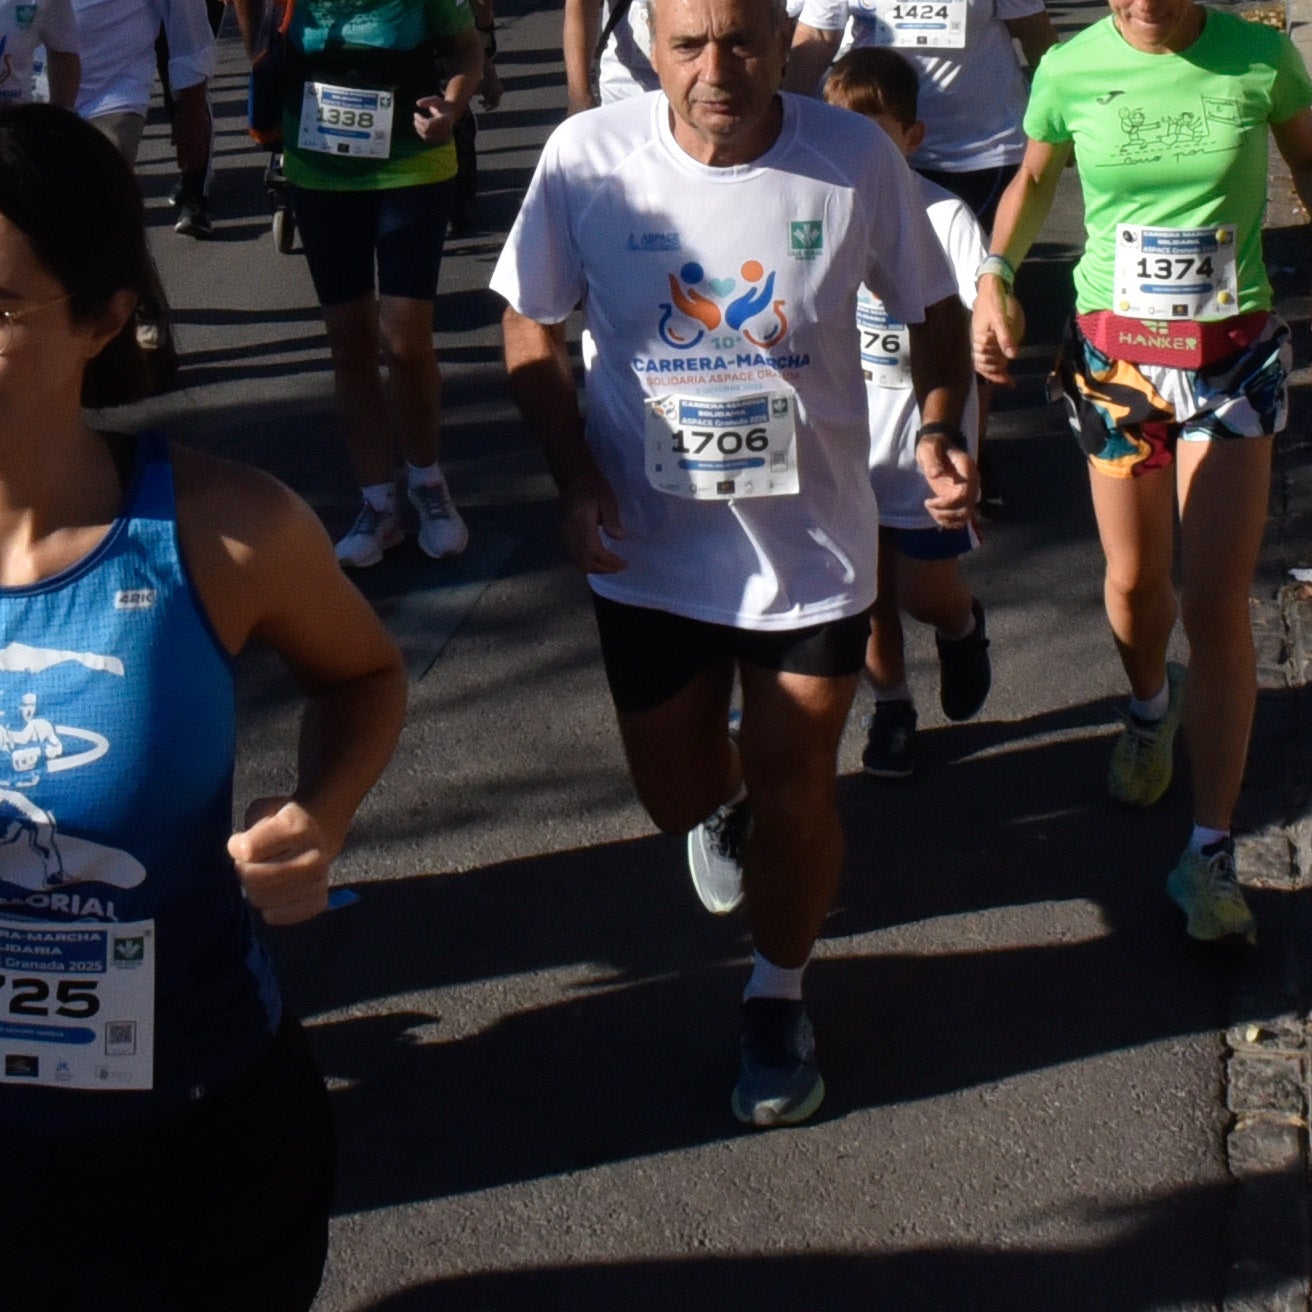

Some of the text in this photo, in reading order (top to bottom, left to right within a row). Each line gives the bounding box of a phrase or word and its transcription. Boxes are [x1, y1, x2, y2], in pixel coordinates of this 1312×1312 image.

[892, 4, 949, 20] 1424
[315, 107, 374, 128] 1338
[1137, 257, 1215, 280] 1374
[1118, 331, 1198, 351] HANKER
[632, 352, 810, 373] CARRERA-MARCHA
[646, 373, 706, 387] SOLIDARIA
[708, 369, 755, 383] ASPACE
[681, 416, 714, 426] ASPACE
[671, 427, 769, 455] 1706
[5, 956, 65, 972] Granada
[69, 959, 104, 973] 2025
